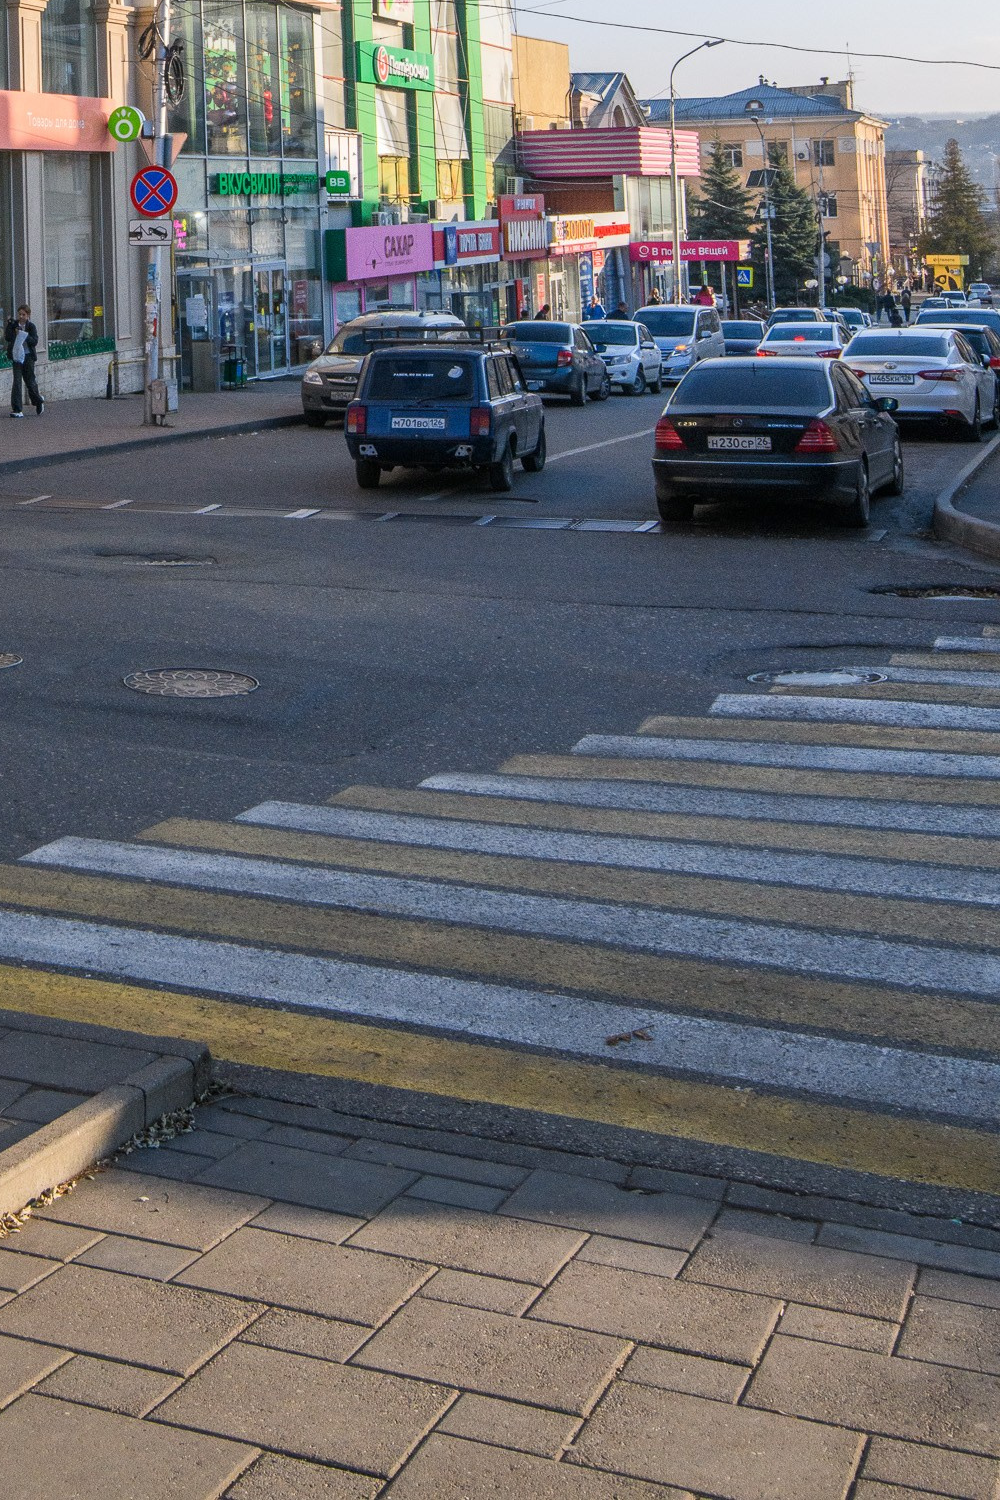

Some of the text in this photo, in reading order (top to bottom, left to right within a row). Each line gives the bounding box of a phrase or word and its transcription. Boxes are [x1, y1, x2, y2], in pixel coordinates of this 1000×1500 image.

[27, 112, 53, 129] Товары
[219, 173, 281, 195] ВКУСВИЛЛ
[384, 234, 414, 258] САХАР
